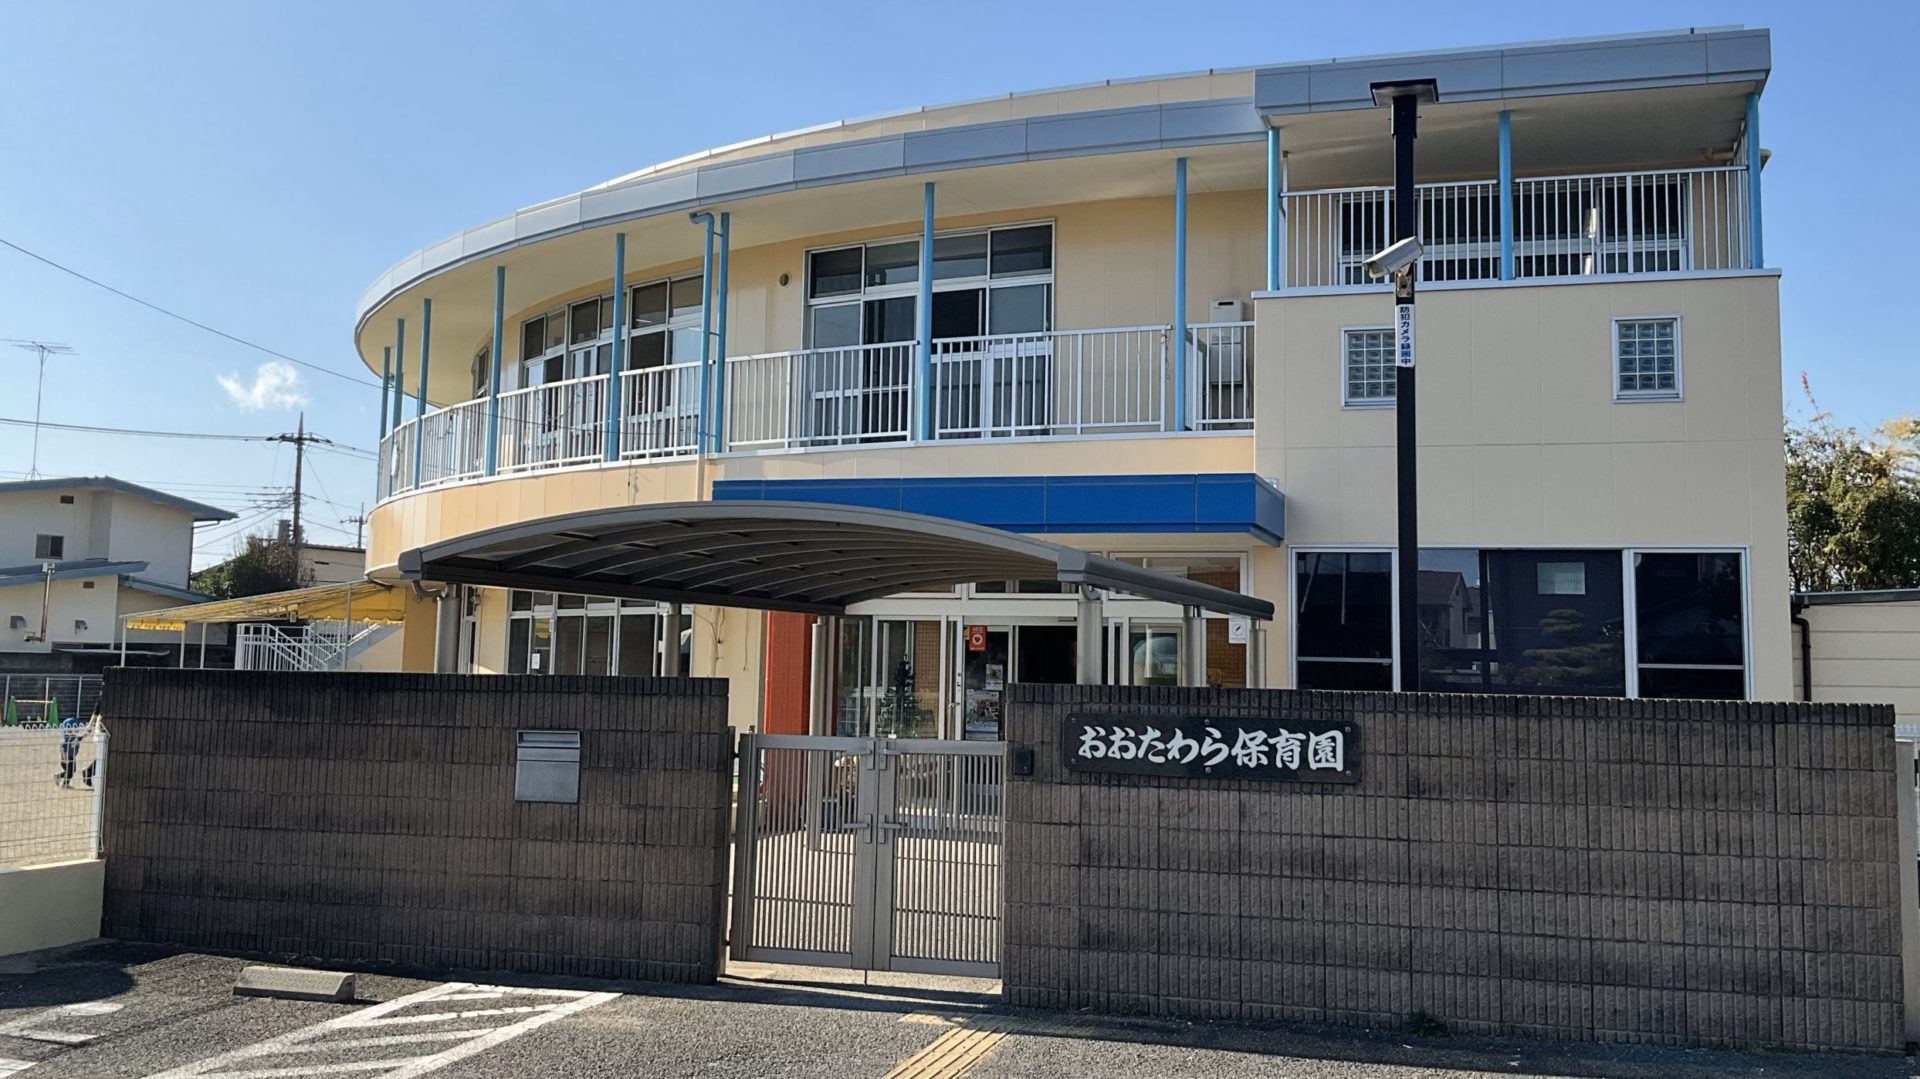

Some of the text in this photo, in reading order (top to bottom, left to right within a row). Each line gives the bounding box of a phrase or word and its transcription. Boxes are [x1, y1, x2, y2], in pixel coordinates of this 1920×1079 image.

[1078, 725, 1345, 772] おおたわら保育園
